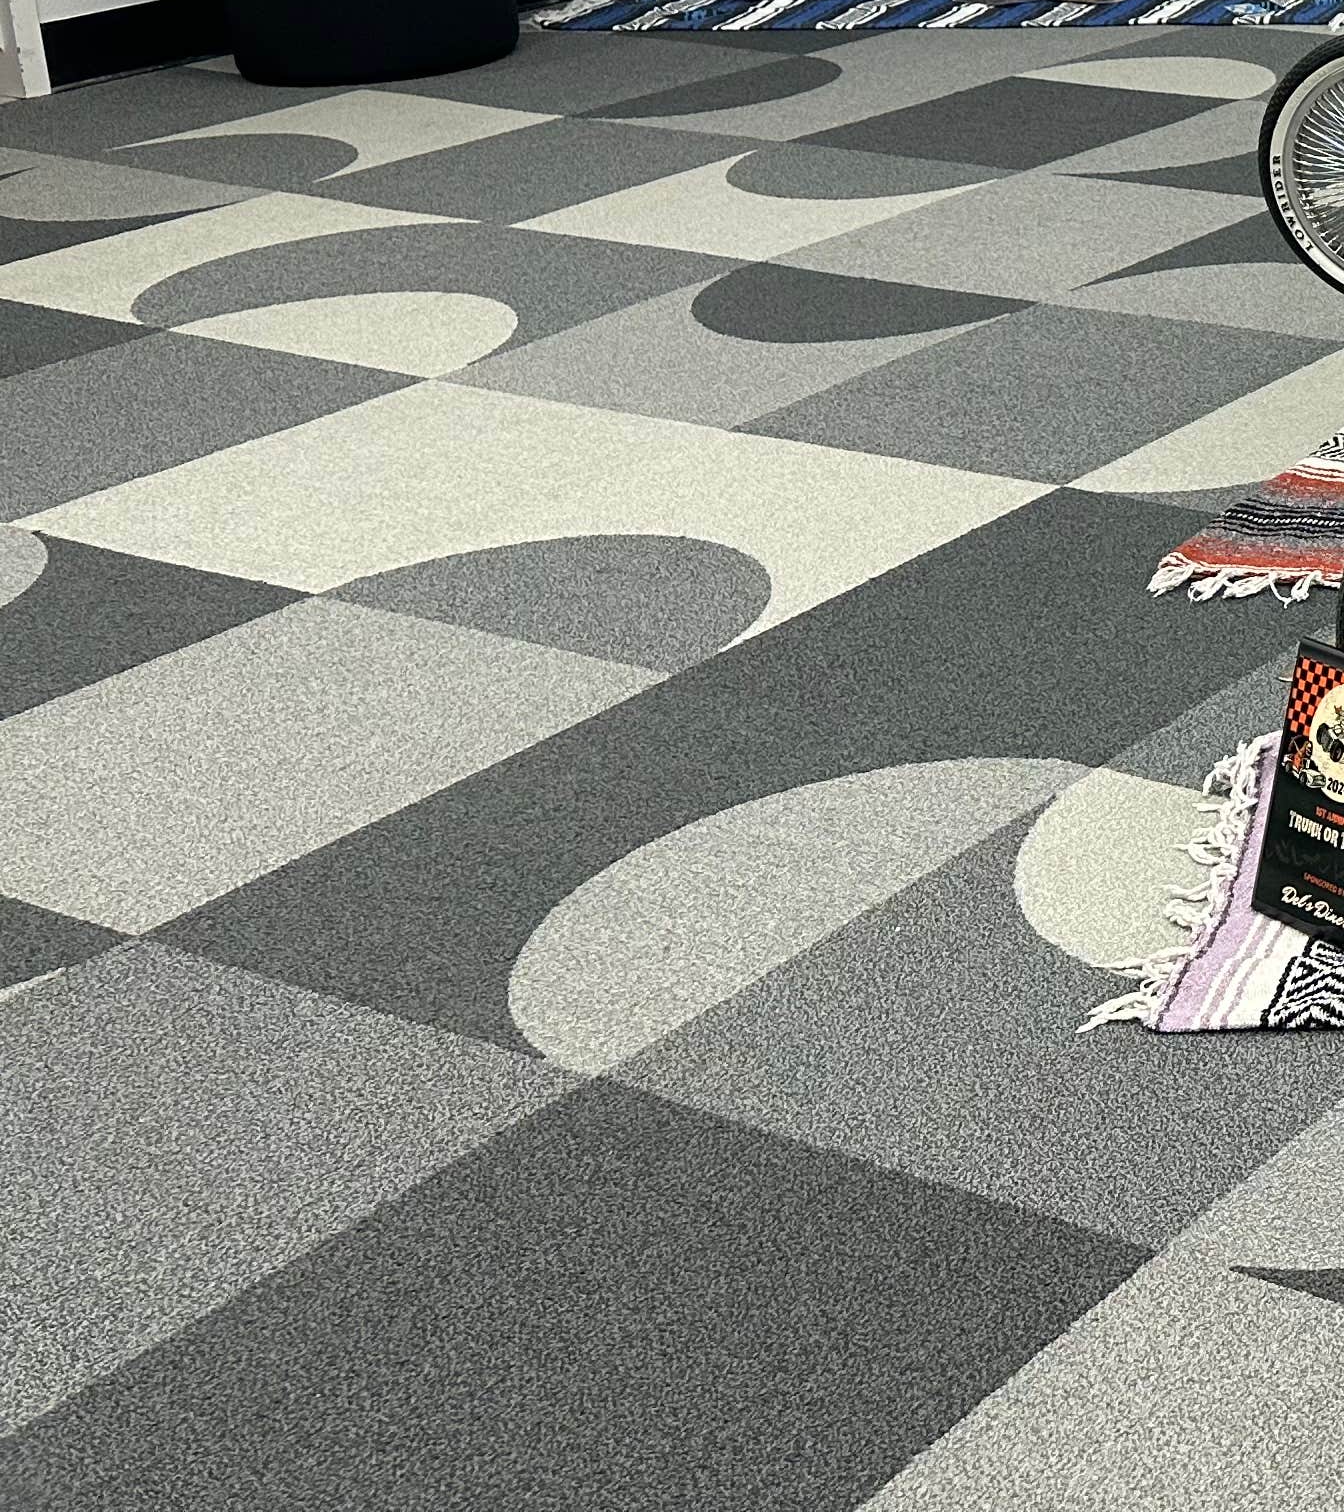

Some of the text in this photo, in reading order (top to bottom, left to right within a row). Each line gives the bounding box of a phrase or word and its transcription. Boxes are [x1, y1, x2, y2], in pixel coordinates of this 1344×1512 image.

[1271, 155, 1313, 253] LOWRIDER
[1288, 809, 1323, 841] TRUNK
[1323, 826, 1339, 848] OR
